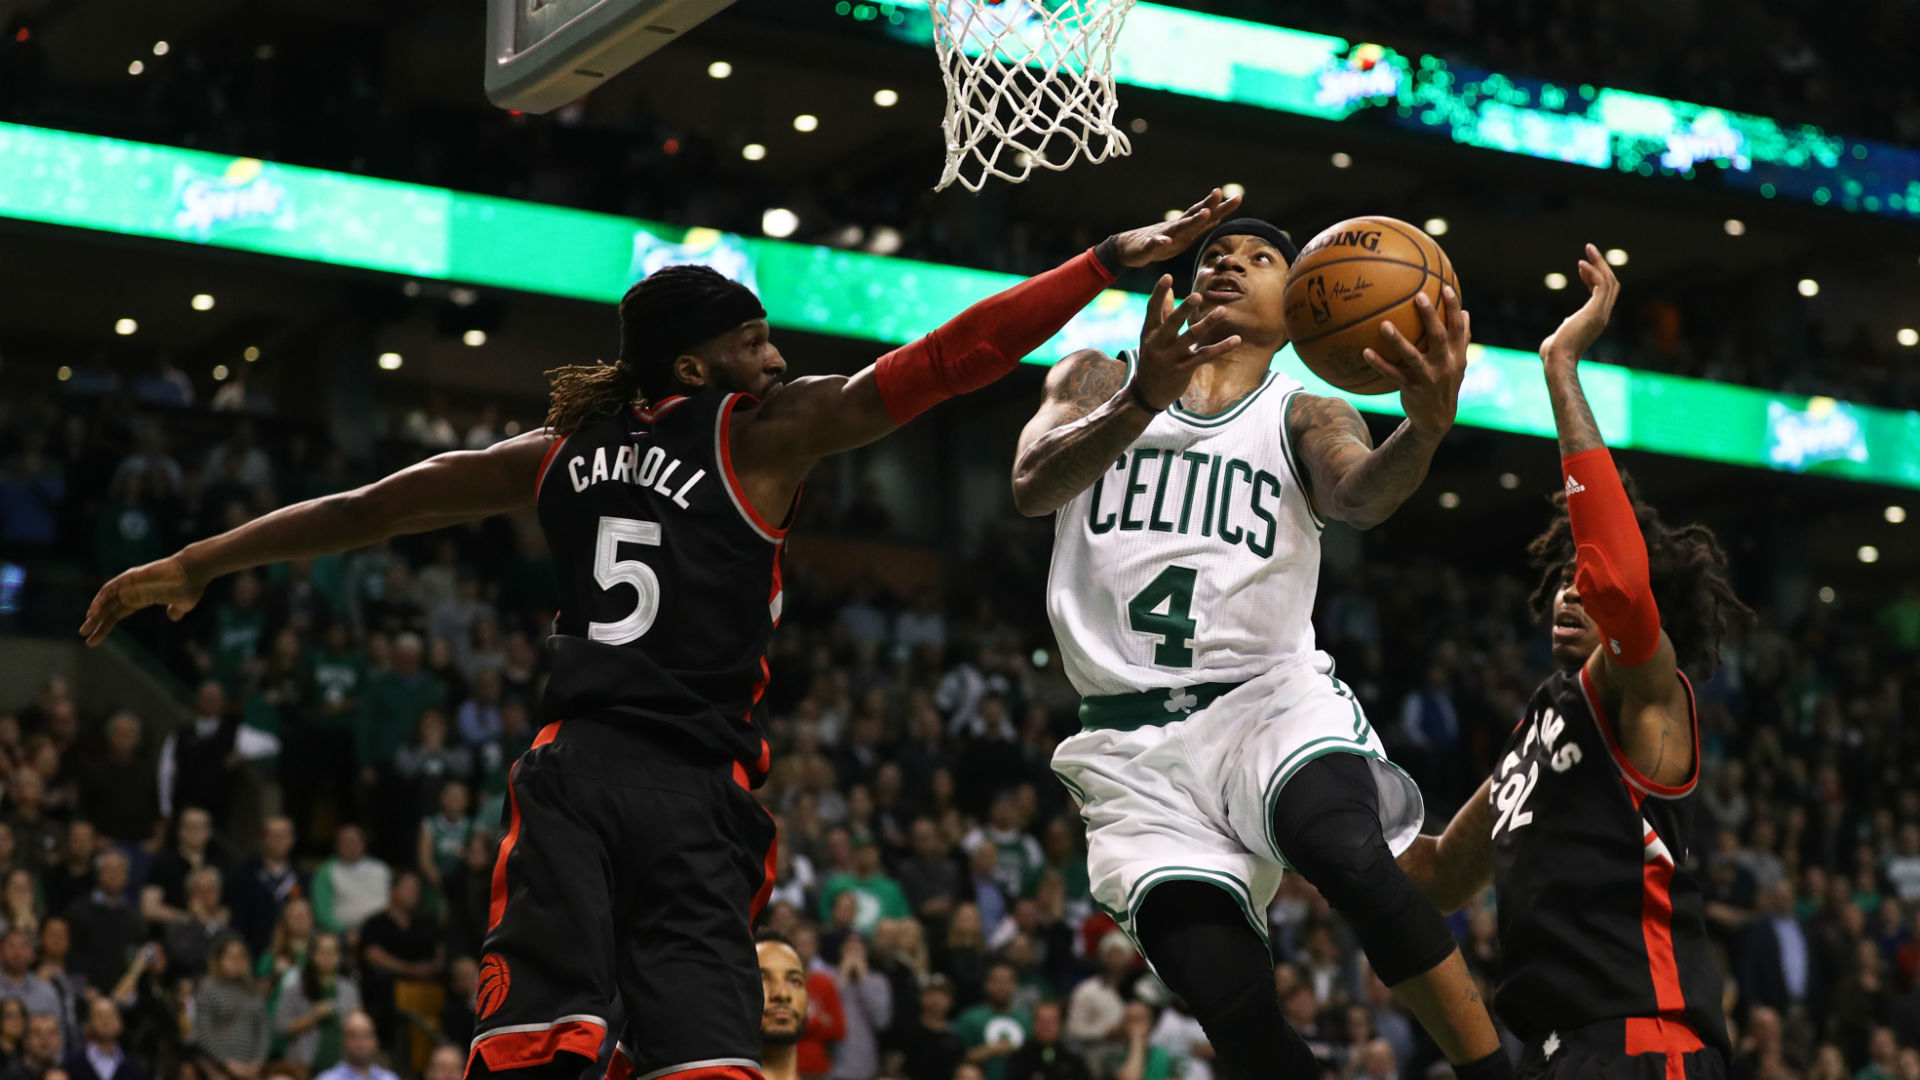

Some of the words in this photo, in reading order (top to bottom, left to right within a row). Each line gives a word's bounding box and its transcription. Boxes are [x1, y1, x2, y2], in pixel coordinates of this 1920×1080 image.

[568, 444, 706, 510] CAROLL
[1089, 447, 1282, 559] CELTICS
[588, 516, 662, 646] 5
[1128, 565, 1198, 668] 4
[1491, 760, 1539, 840] 92
